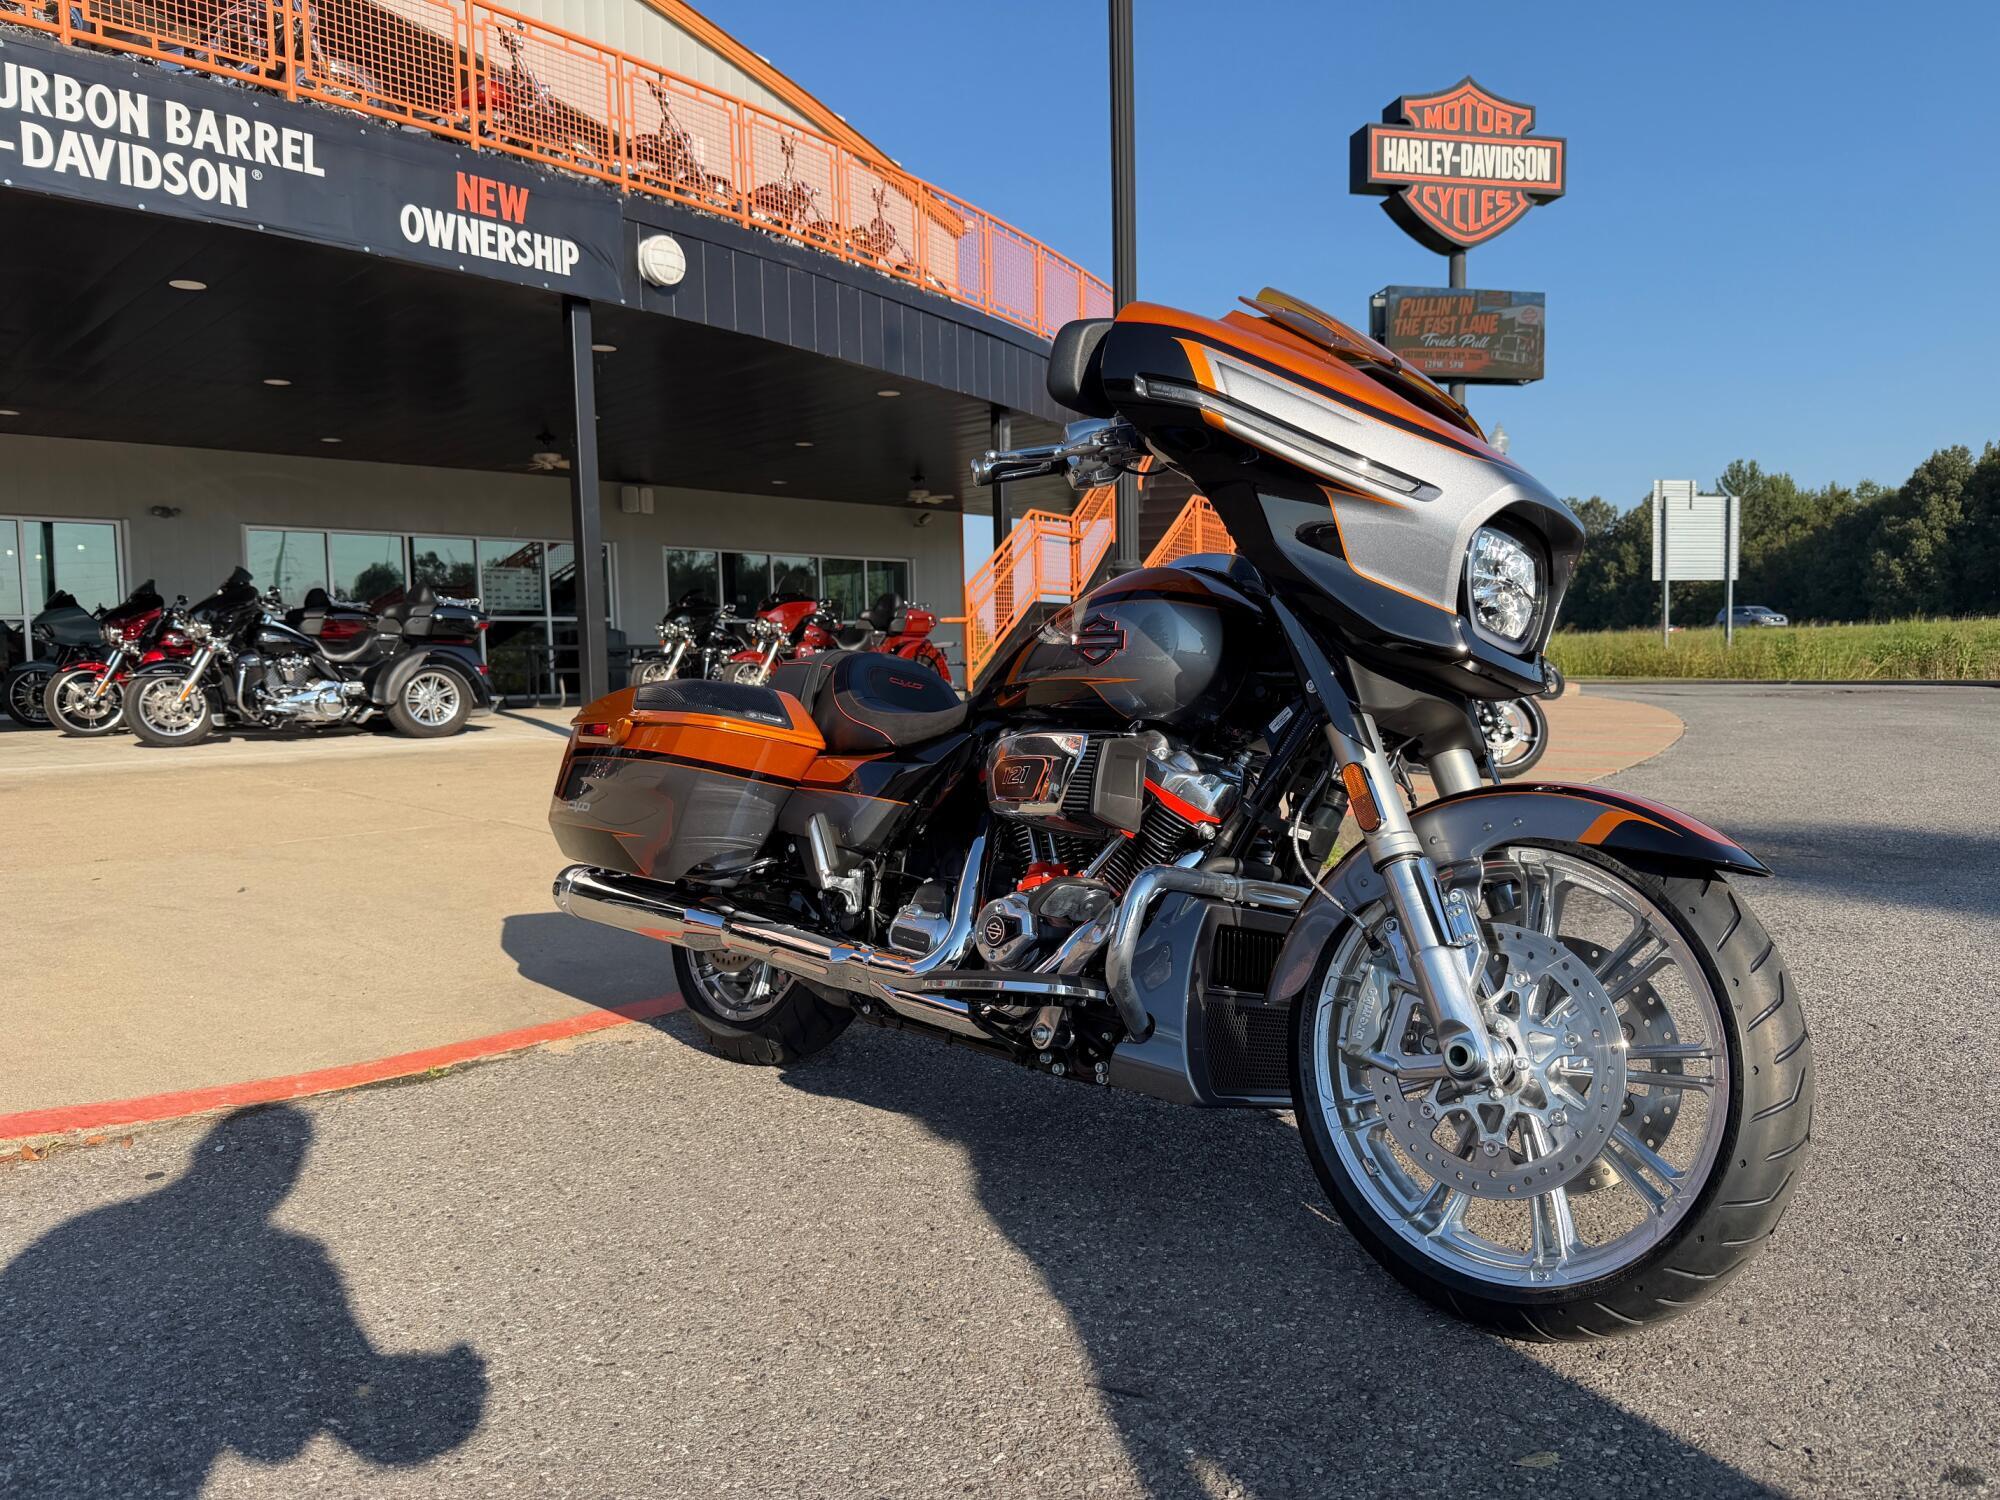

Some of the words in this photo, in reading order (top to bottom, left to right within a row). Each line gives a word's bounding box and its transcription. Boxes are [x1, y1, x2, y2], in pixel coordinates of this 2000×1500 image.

[1424, 94, 1513, 136] MOTOR
[165, 100, 325, 177] BARREL
[1383, 137, 1551, 182] HARLEY-DAVIDSON
[456, 171, 529, 225] NEW
[1422, 184, 1514, 232] CYCLES
[400, 203, 580, 276] OWNERSHIP
[1394, 318, 1421, 336] THE
[1423, 316, 1458, 335] FAST
[1459, 314, 1499, 335] LANE
[1399, 297, 1457, 318] PULLIN'
[1458, 296, 1474, 316] IN
[1420, 333, 1457, 348] Truck
[1459, 334, 1490, 349] Pull
[1002, 765, 1031, 785] 121
[1353, 987, 1378, 1040] brembo
